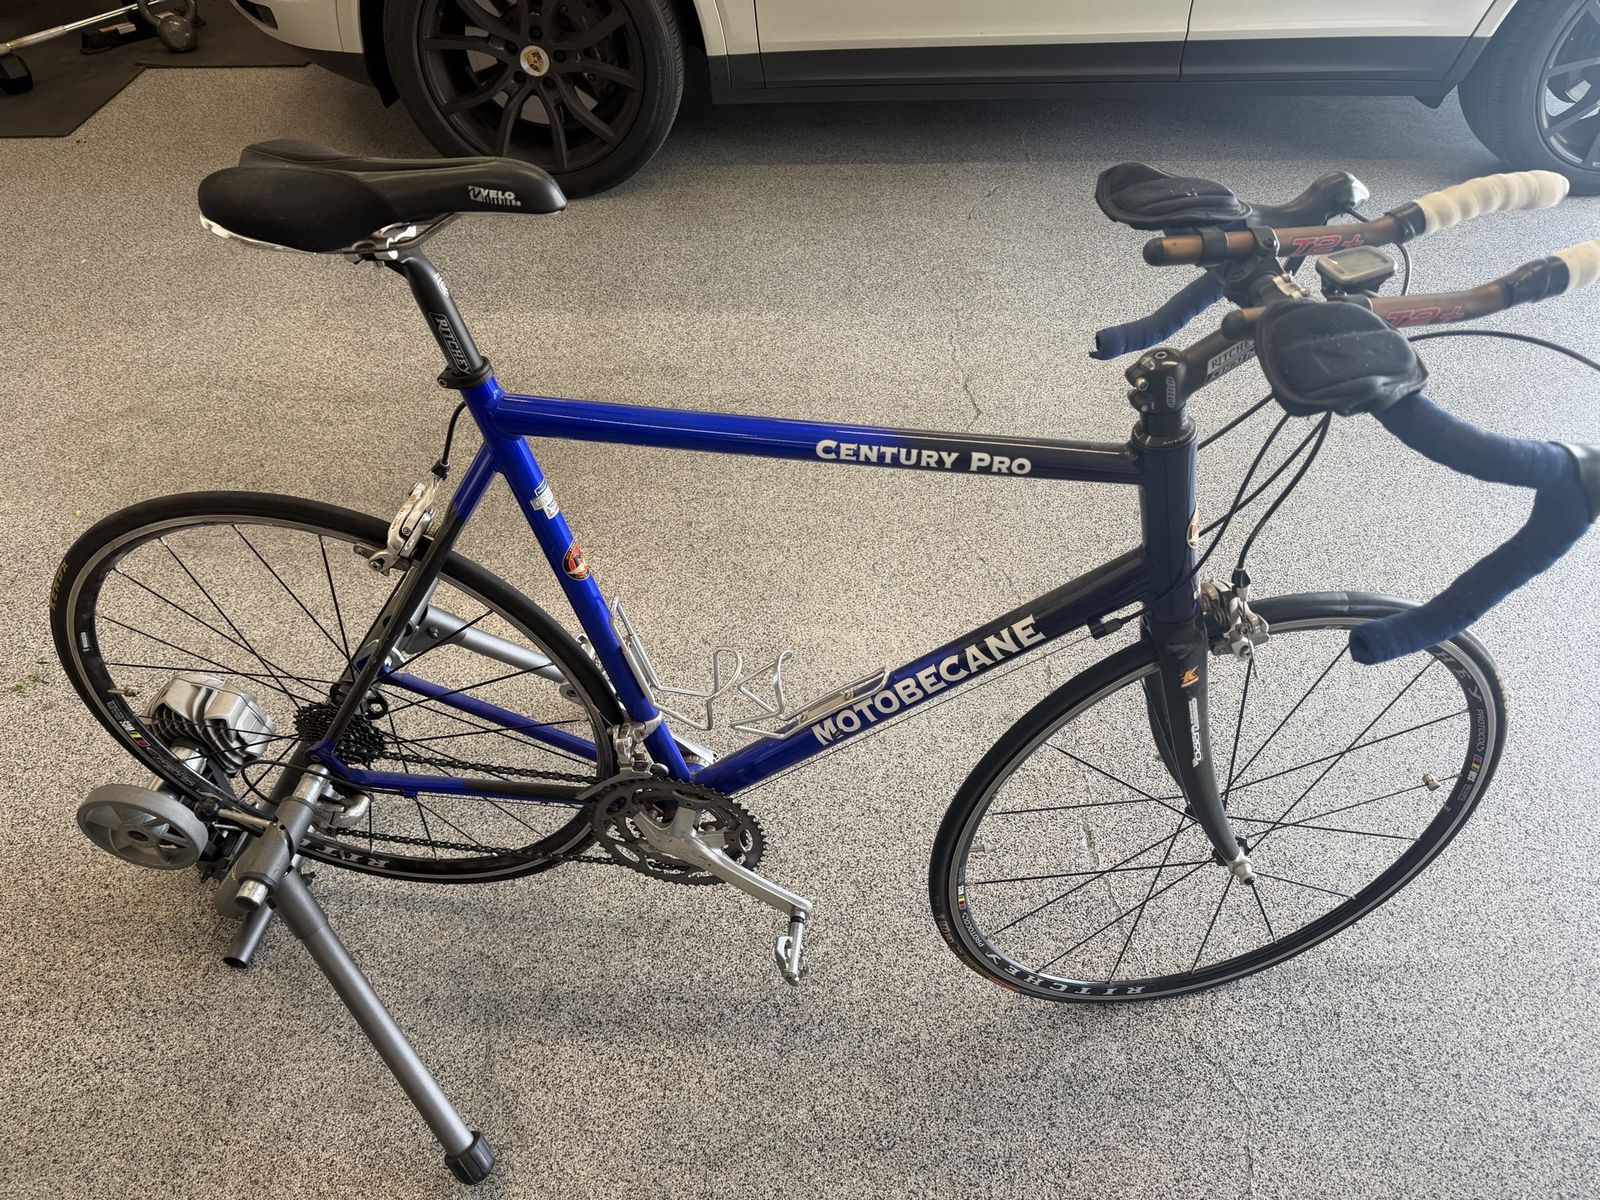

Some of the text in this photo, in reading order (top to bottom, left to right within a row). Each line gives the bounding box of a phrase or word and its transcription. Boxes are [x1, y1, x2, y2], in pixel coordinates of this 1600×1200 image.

[480, 187, 516, 200] VELO
[435, 317, 473, 375] RITCHEY
[1210, 340, 1254, 369] RITCHE
[811, 613, 1047, 746] MOTOBECANE
[984, 951, 1146, 996] RITCHEY
